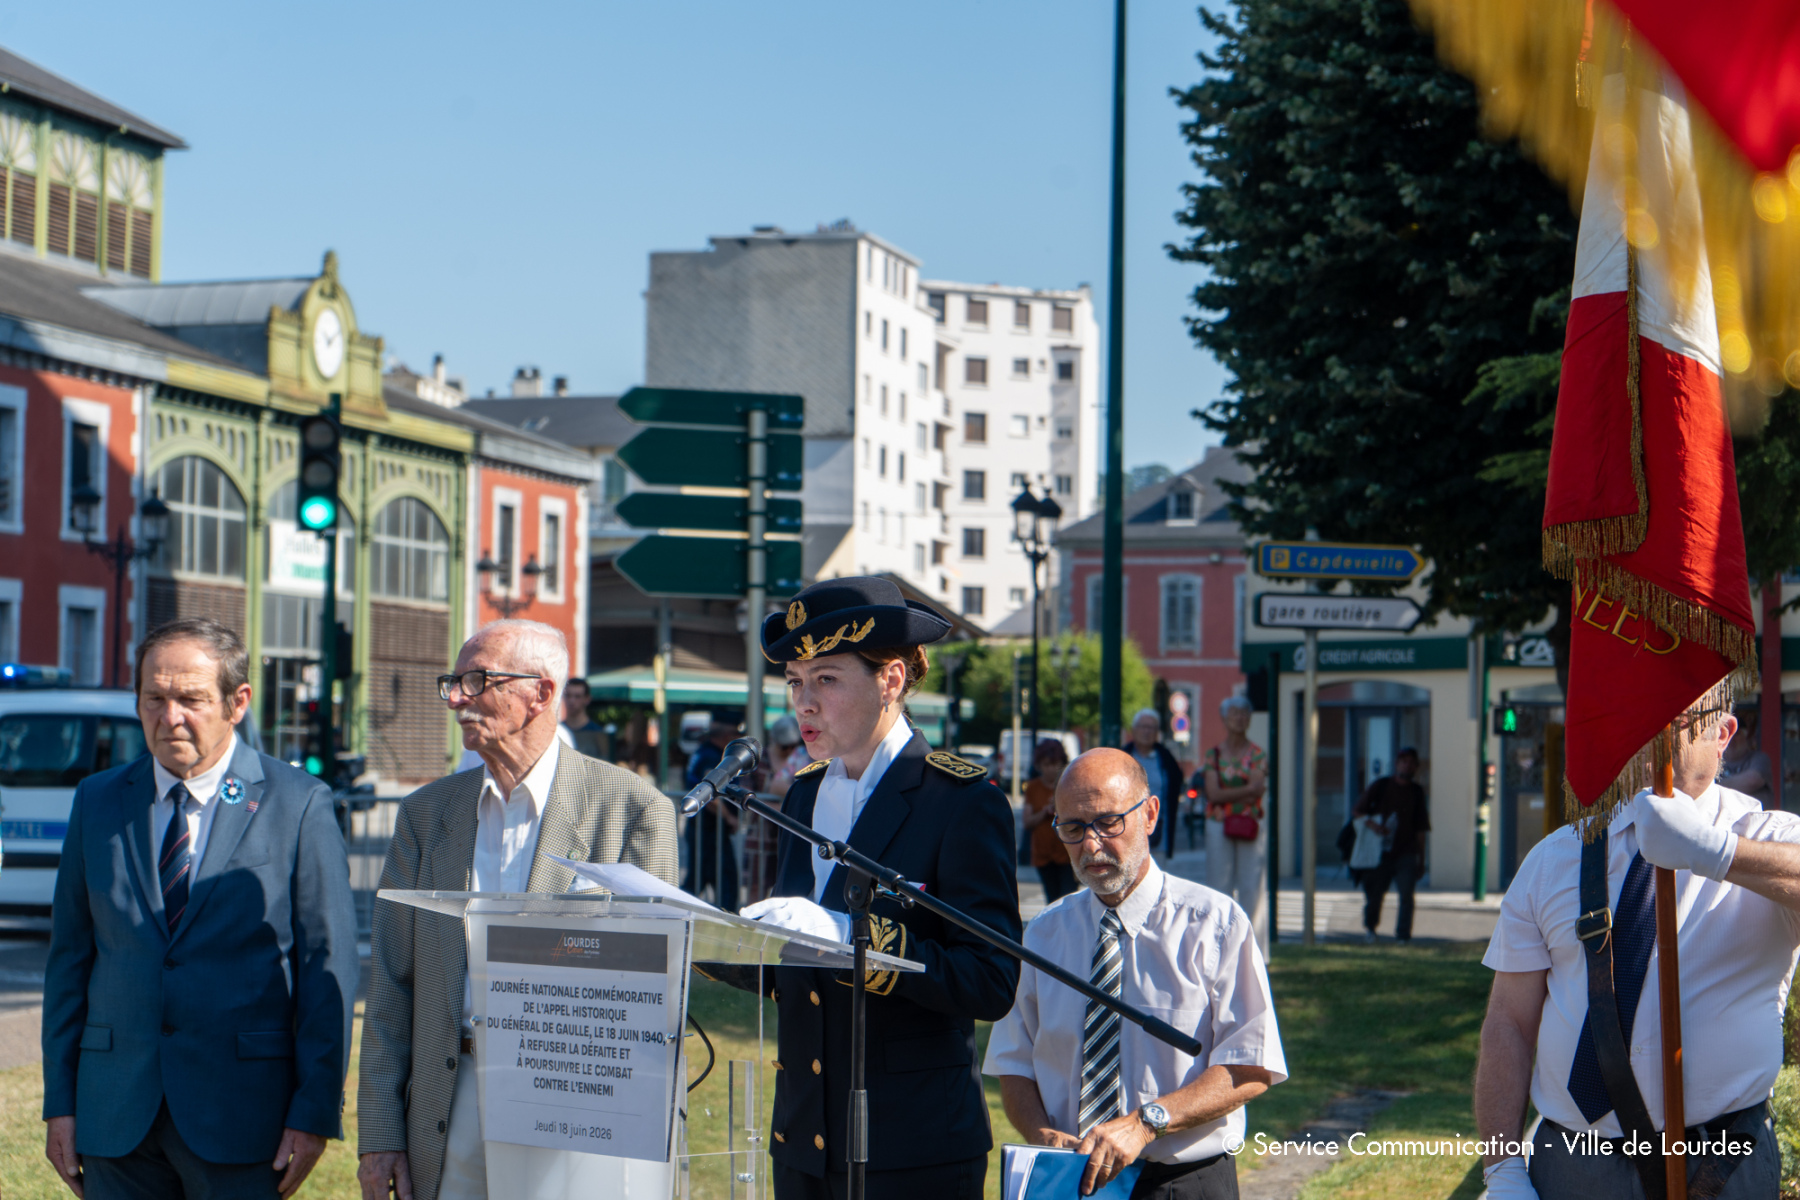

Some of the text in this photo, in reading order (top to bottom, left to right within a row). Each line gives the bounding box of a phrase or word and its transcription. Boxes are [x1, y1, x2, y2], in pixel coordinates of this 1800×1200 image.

[1297, 551, 1404, 573] Capdevielle
[1267, 601, 1382, 622] gare routière
[1360, 648, 1415, 663] AGRICOLE
[490, 978, 663, 1005] JOURNÉE NATIONALE COMMÉMORATIVE
[523, 1002, 627, 1023] DE L'APPEL HISTORIQUE
[487, 1014, 666, 1046] DU GÉNÉRAL DE GAULLE, LE 18 JUIN 1940,
[519, 1034, 631, 1060] À REFUSER LA DÉFAITE ET
[516, 1052, 633, 1080] À POURSUIVRE LE COMBAT
[533, 1077, 614, 1097] CONTRE L'ENNEMI
[534, 1119, 612, 1140] Jeudi 18 juin 2026
